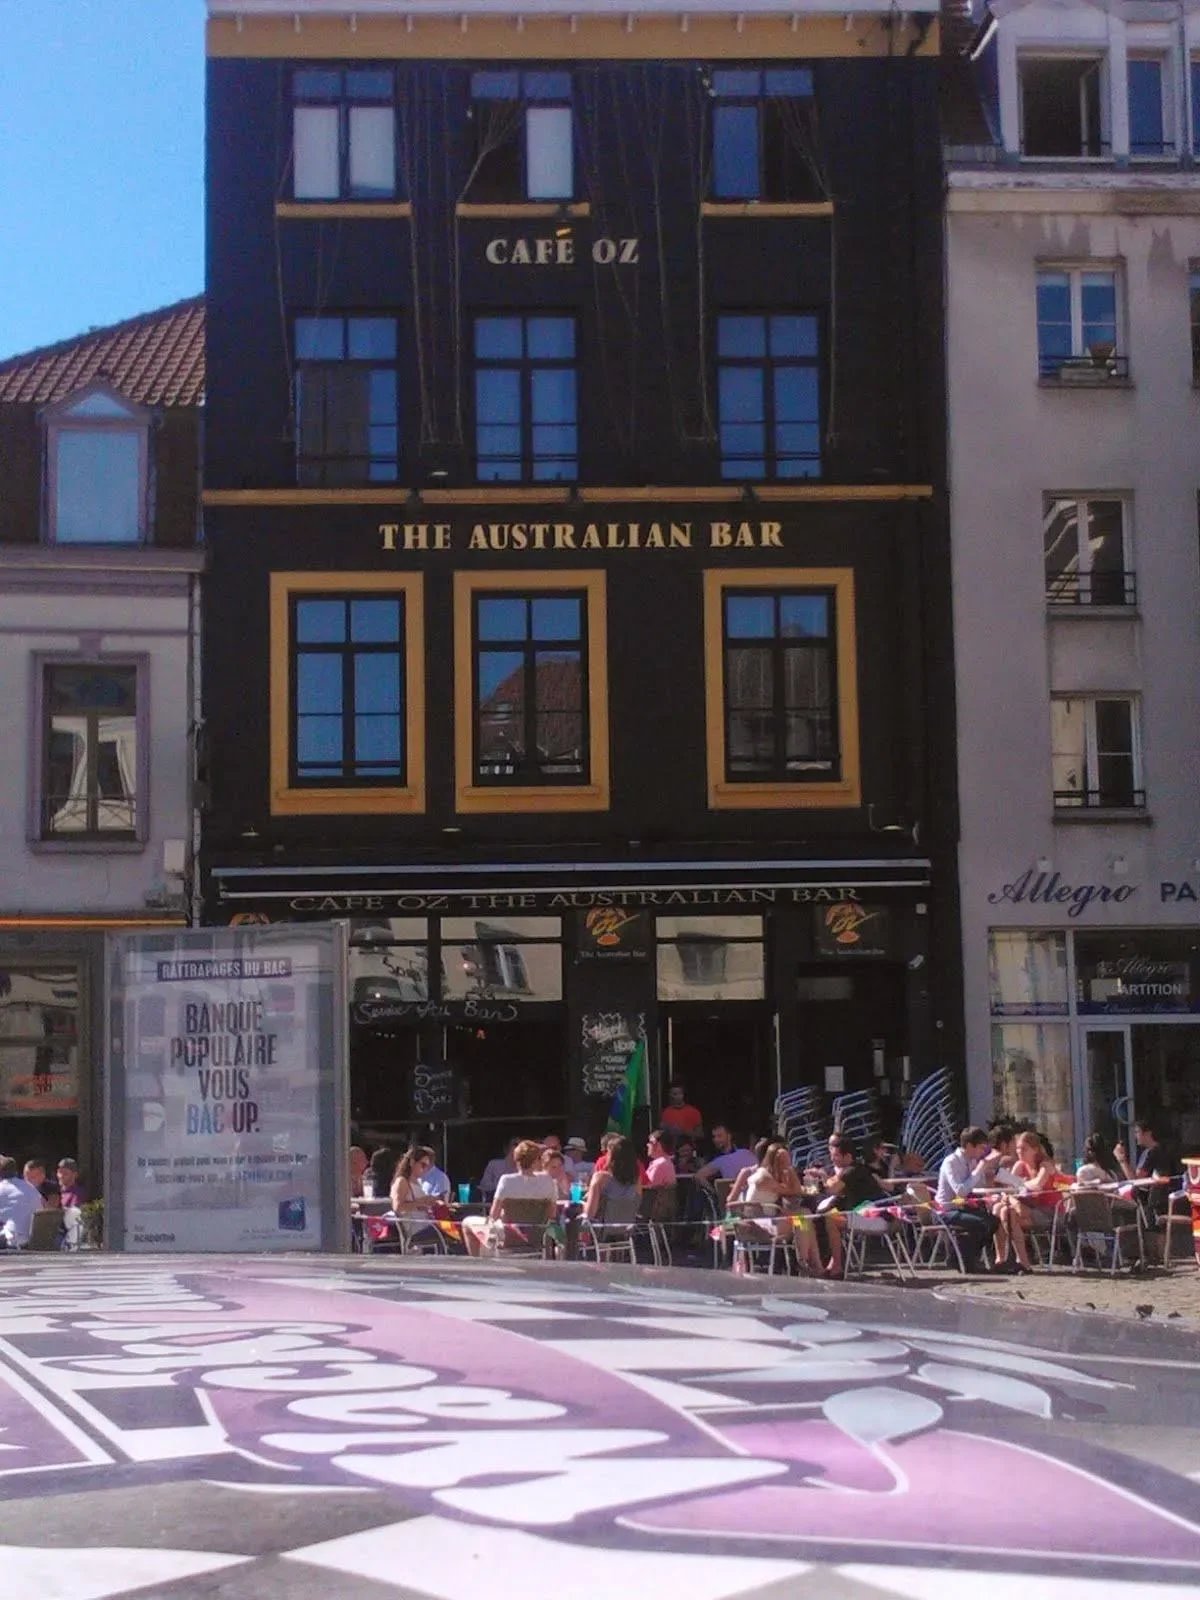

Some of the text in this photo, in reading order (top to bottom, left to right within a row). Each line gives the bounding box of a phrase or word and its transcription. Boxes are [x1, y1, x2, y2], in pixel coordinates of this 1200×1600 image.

[485, 227, 640, 264] CAFÉ OZ
[379, 521, 784, 550] THE AUSTRALIAN BAR
[289, 887, 862, 911] CAFE OZ THE AUSTRALIAN BAR
[987, 869, 1200, 918] Allegro PA
[243, 960, 260, 977] DU
[263, 959, 287, 976] BAC
[185, 1000, 264, 1036] BANQUE
[170, 1034, 278, 1068] POPULAIRE
[198, 1069, 250, 1101] VOUS
[186, 1102, 261, 1136] BAC UP.
